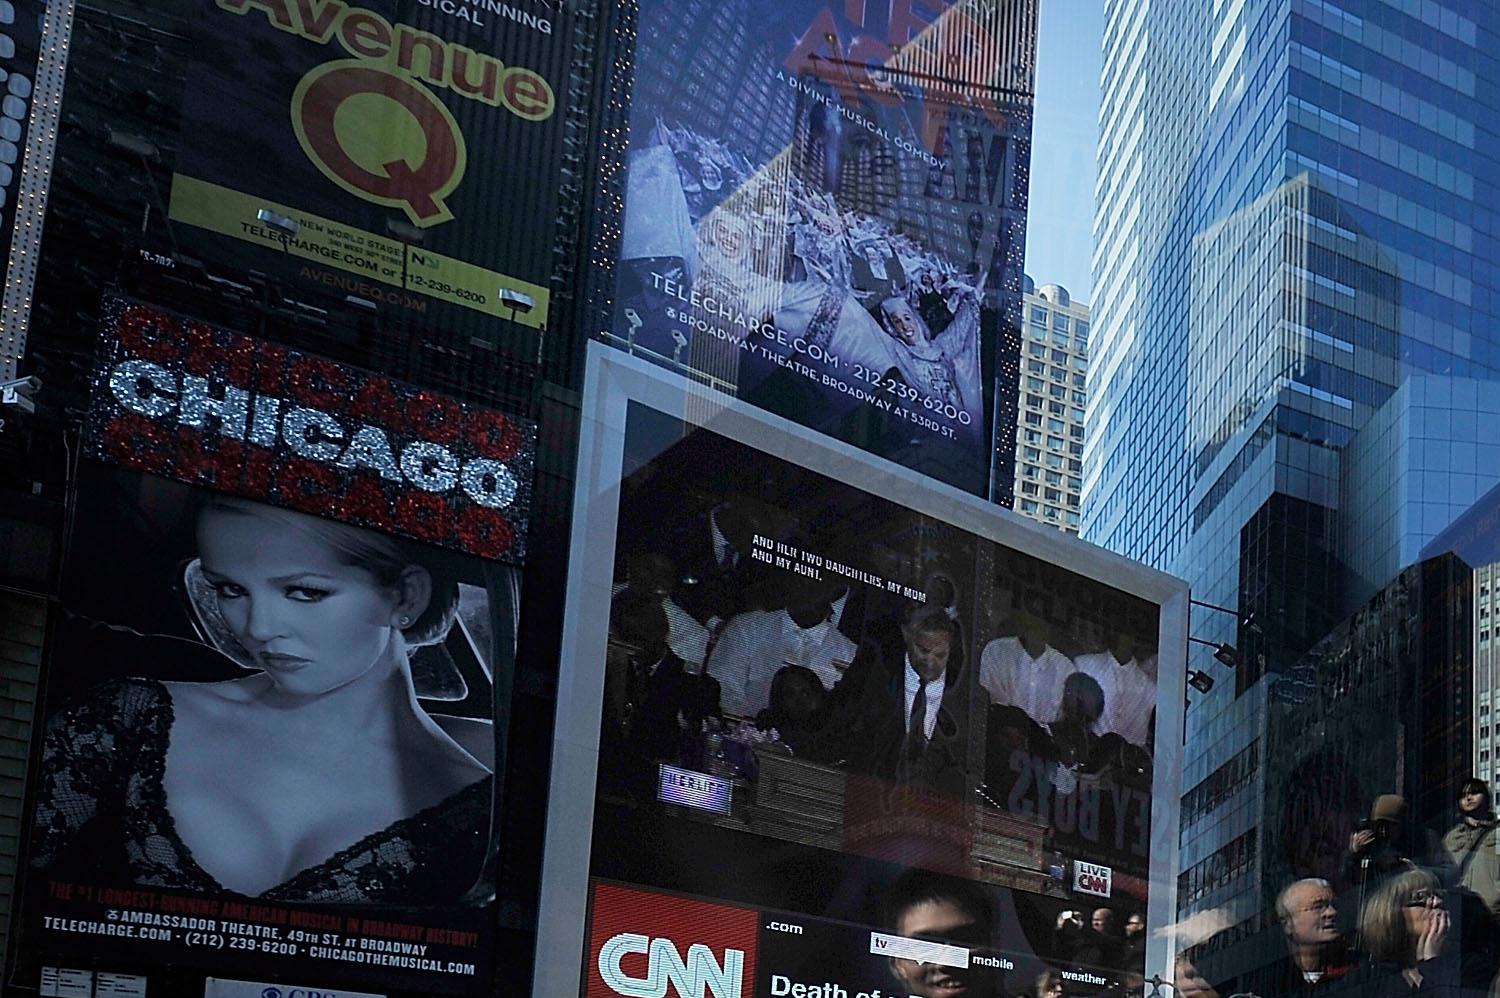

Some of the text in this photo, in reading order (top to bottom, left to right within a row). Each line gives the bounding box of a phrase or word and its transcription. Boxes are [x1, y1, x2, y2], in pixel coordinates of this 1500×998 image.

[291, 58, 466, 227] Q
[790, 79, 834, 107] DIVINE
[837, 105, 889, 142] MUSICAL
[894, 136, 947, 172] COMEDY
[240, 222, 379, 273] TELECHARGE.COM
[650, 271, 972, 427] TELECHARGE.COM 212-239-6200
[678, 311, 758, 355] BROADWAY
[822, 373, 893, 412] BROADWAY
[894, 405, 910, 422] AT
[911, 411, 941, 433] 53RD
[942, 424, 958, 441] ST.
[109, 358, 519, 510] CHICAGO
[775, 556, 792, 570] MY
[1078, 875, 1107, 894] CNN
[1080, 862, 1108, 878] LIVE
[44, 916, 476, 976] TELECHARGE.COM (212) 239-6200 CHICAGOTHEMUSICAL.COM
[121, 911, 216, 932] AMBASSADOR
[287, 930, 319, 945] 49TH
[345, 938, 357, 949] AT
[360, 938, 427, 957] BROADWAY
[765, 919, 804, 936] .com
[874, 937, 888, 950] tv
[972, 953, 1015, 971] mobile
[1061, 969, 1107, 987] weather
